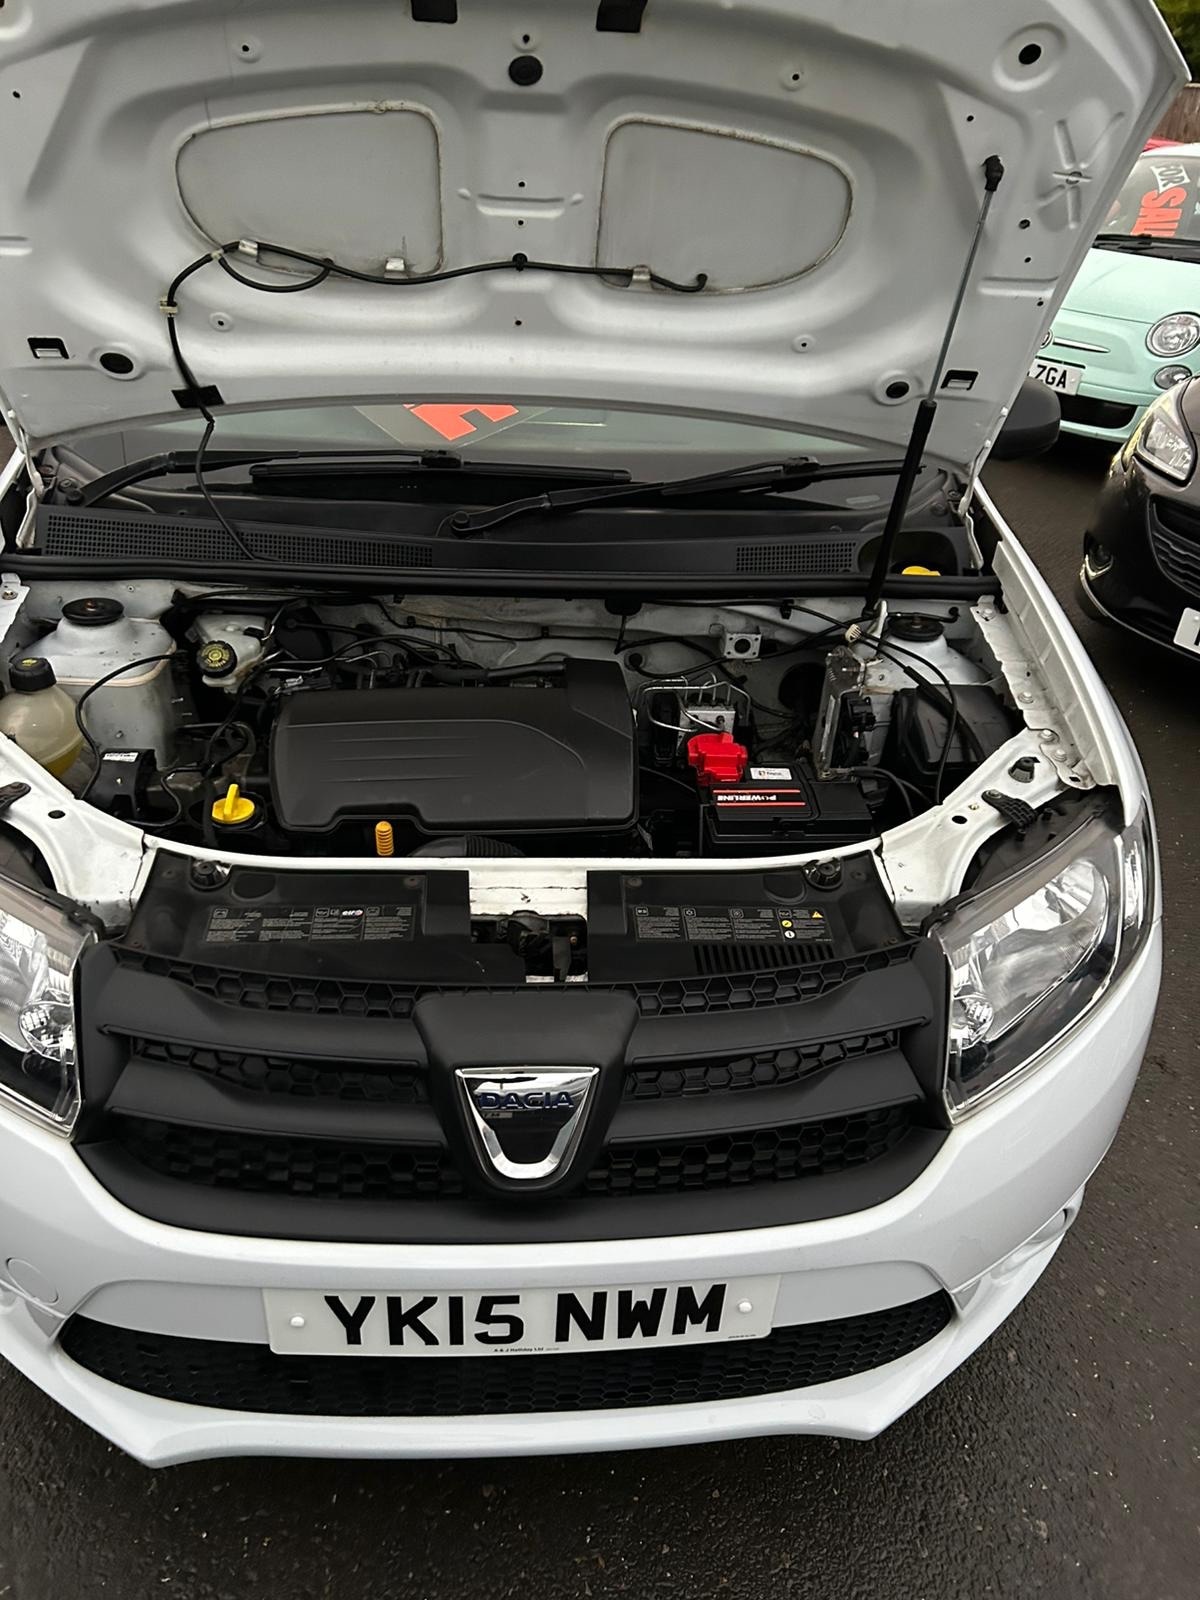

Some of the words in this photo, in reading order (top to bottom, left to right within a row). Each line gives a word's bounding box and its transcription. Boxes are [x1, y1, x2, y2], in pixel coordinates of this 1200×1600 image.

[1130, 186, 1188, 238] SAL
[477, 1091, 575, 1110] DACIA
[323, 1294, 525, 1347] YK15
[555, 1283, 728, 1344] NWM
